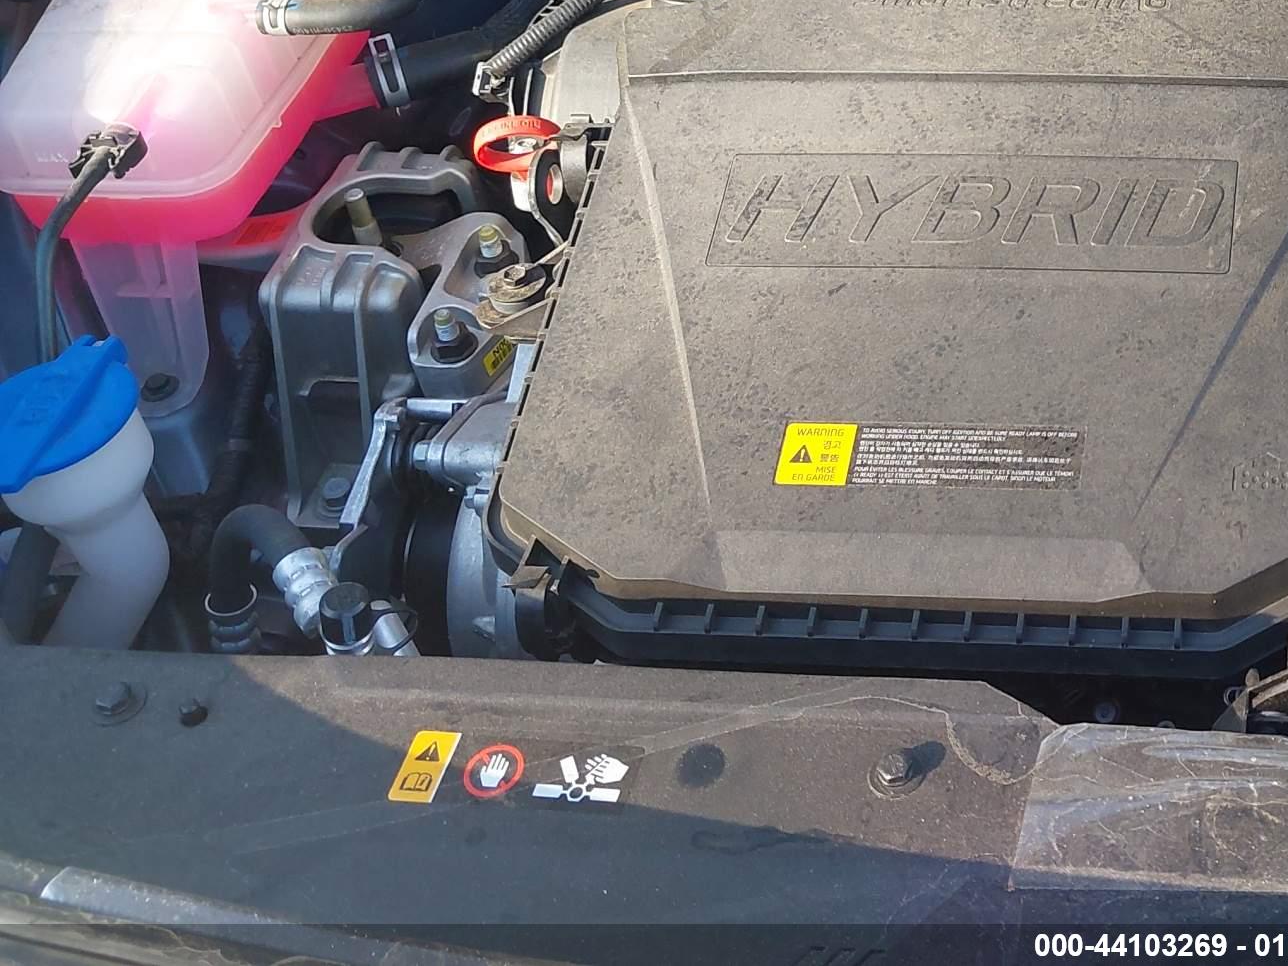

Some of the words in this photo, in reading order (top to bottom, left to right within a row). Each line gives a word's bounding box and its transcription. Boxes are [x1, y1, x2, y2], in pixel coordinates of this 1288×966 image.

[725, 174, 1226, 247] HYBRID
[797, 428, 844, 437] WARNING
[824, 440, 842, 450] 경고
[816, 466, 836, 474] MISE
[792, 473, 803, 481] EN
[806, 474, 835, 482] GARDE
